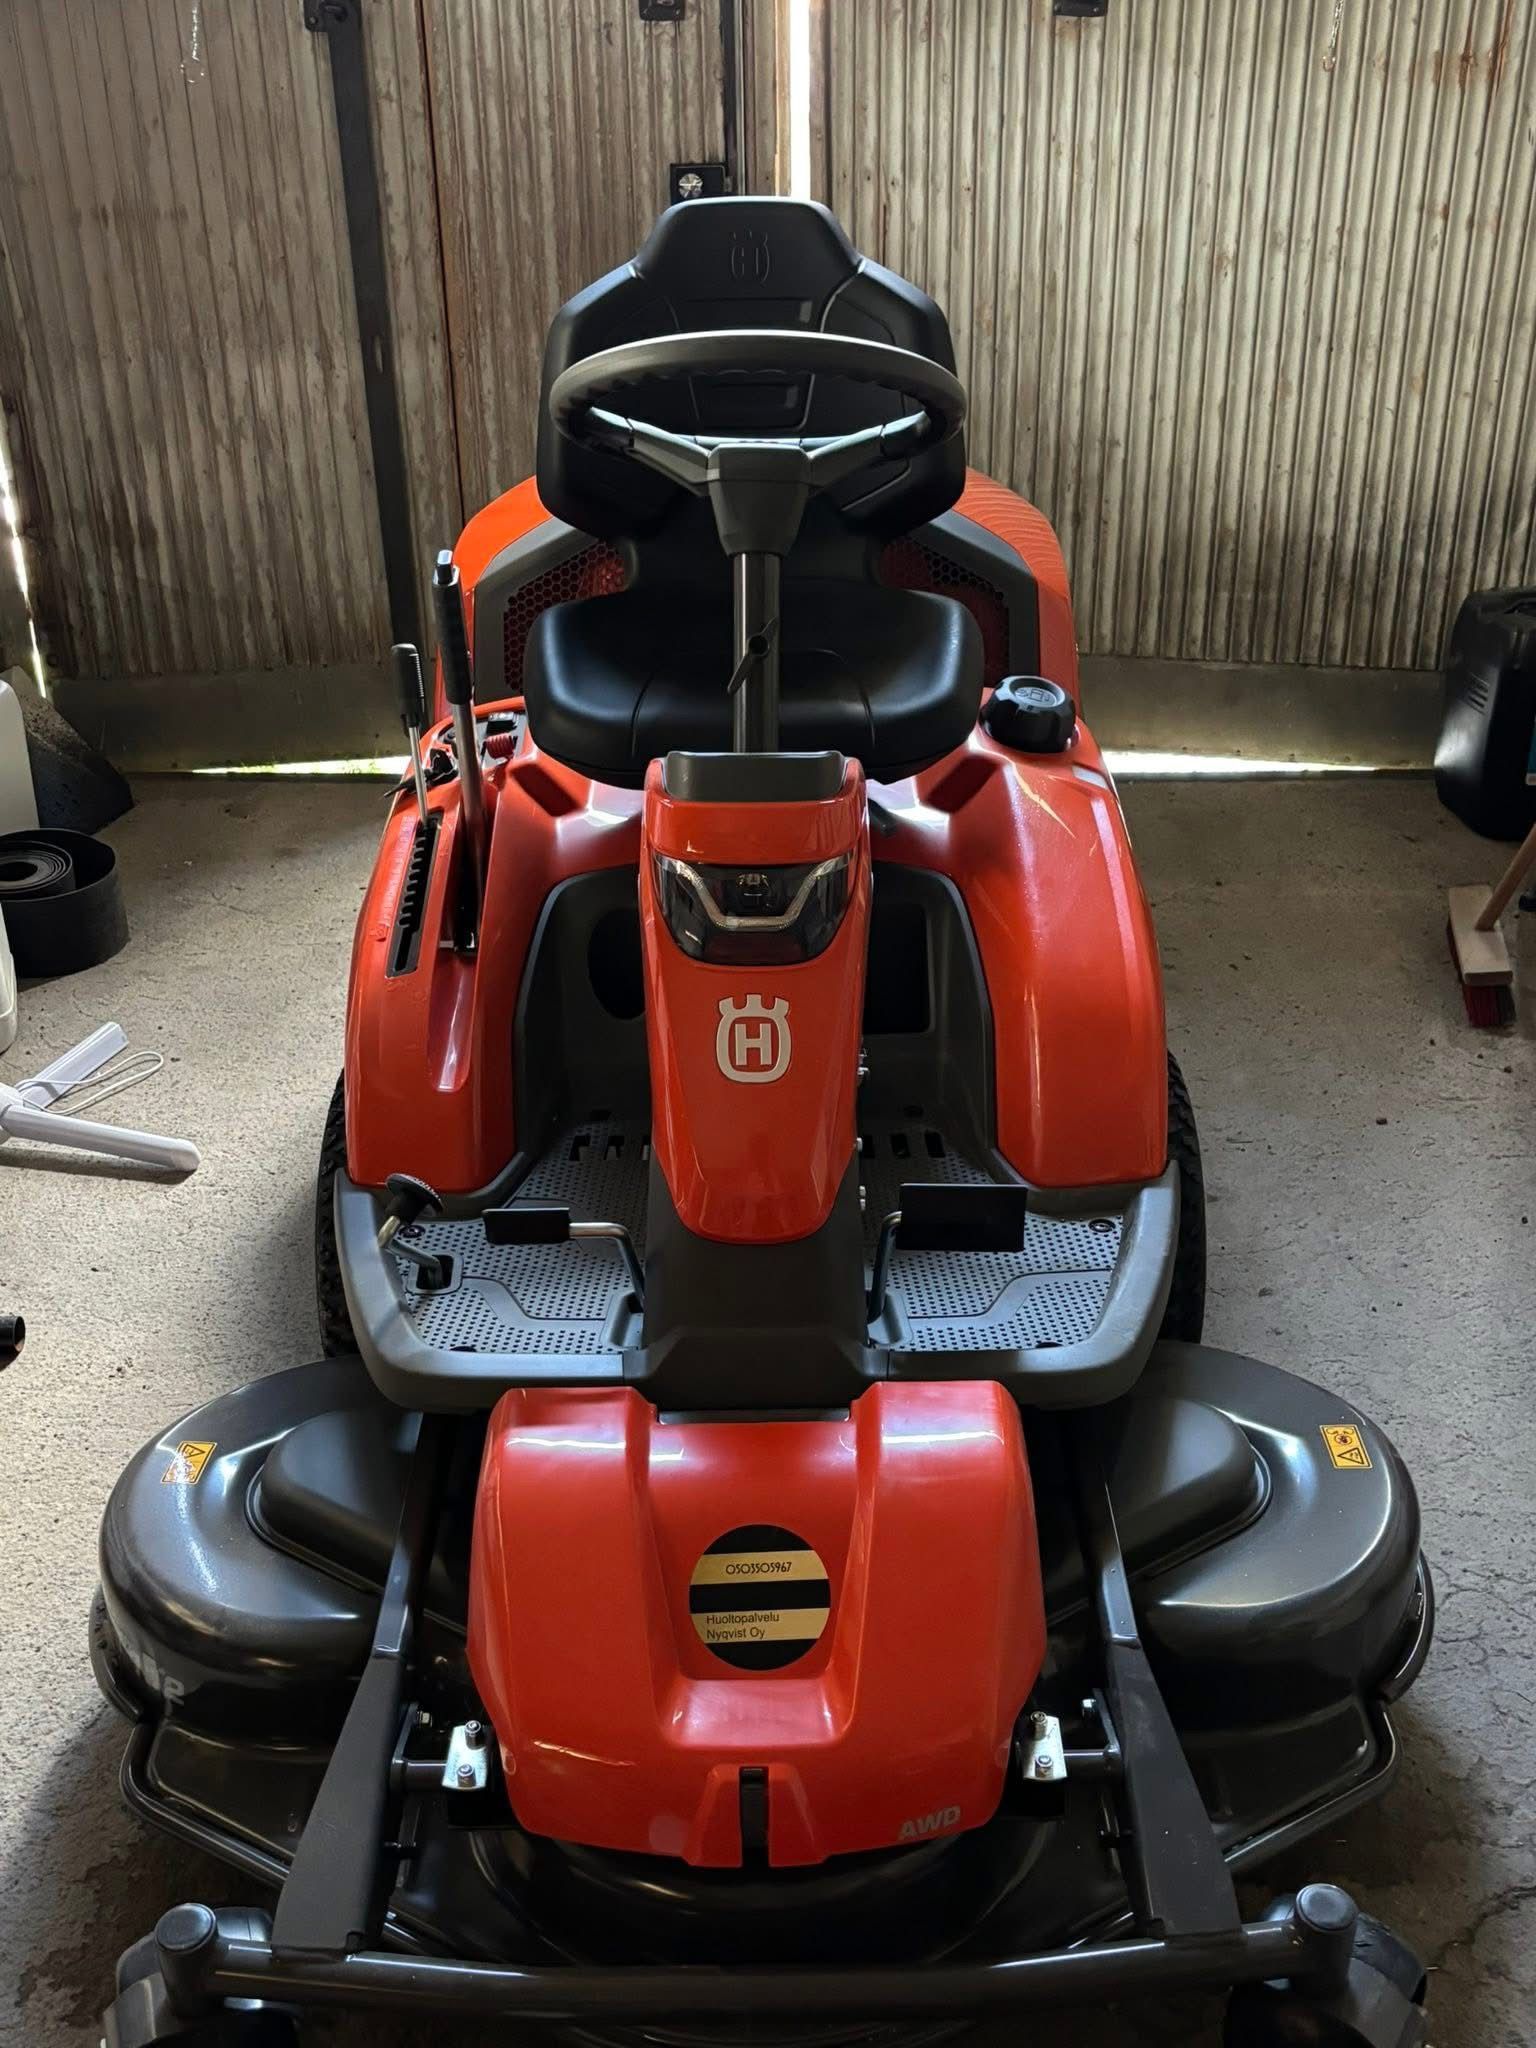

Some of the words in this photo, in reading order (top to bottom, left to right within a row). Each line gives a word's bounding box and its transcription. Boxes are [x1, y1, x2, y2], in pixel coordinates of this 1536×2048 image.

[725, 1561, 793, 1575] 0503505967
[706, 1612, 780, 1625] Huoltopalvelu
[706, 1628, 747, 1641] Nyqvist
[749, 1627, 765, 1639] Oy
[899, 1805, 961, 1841] AWD
